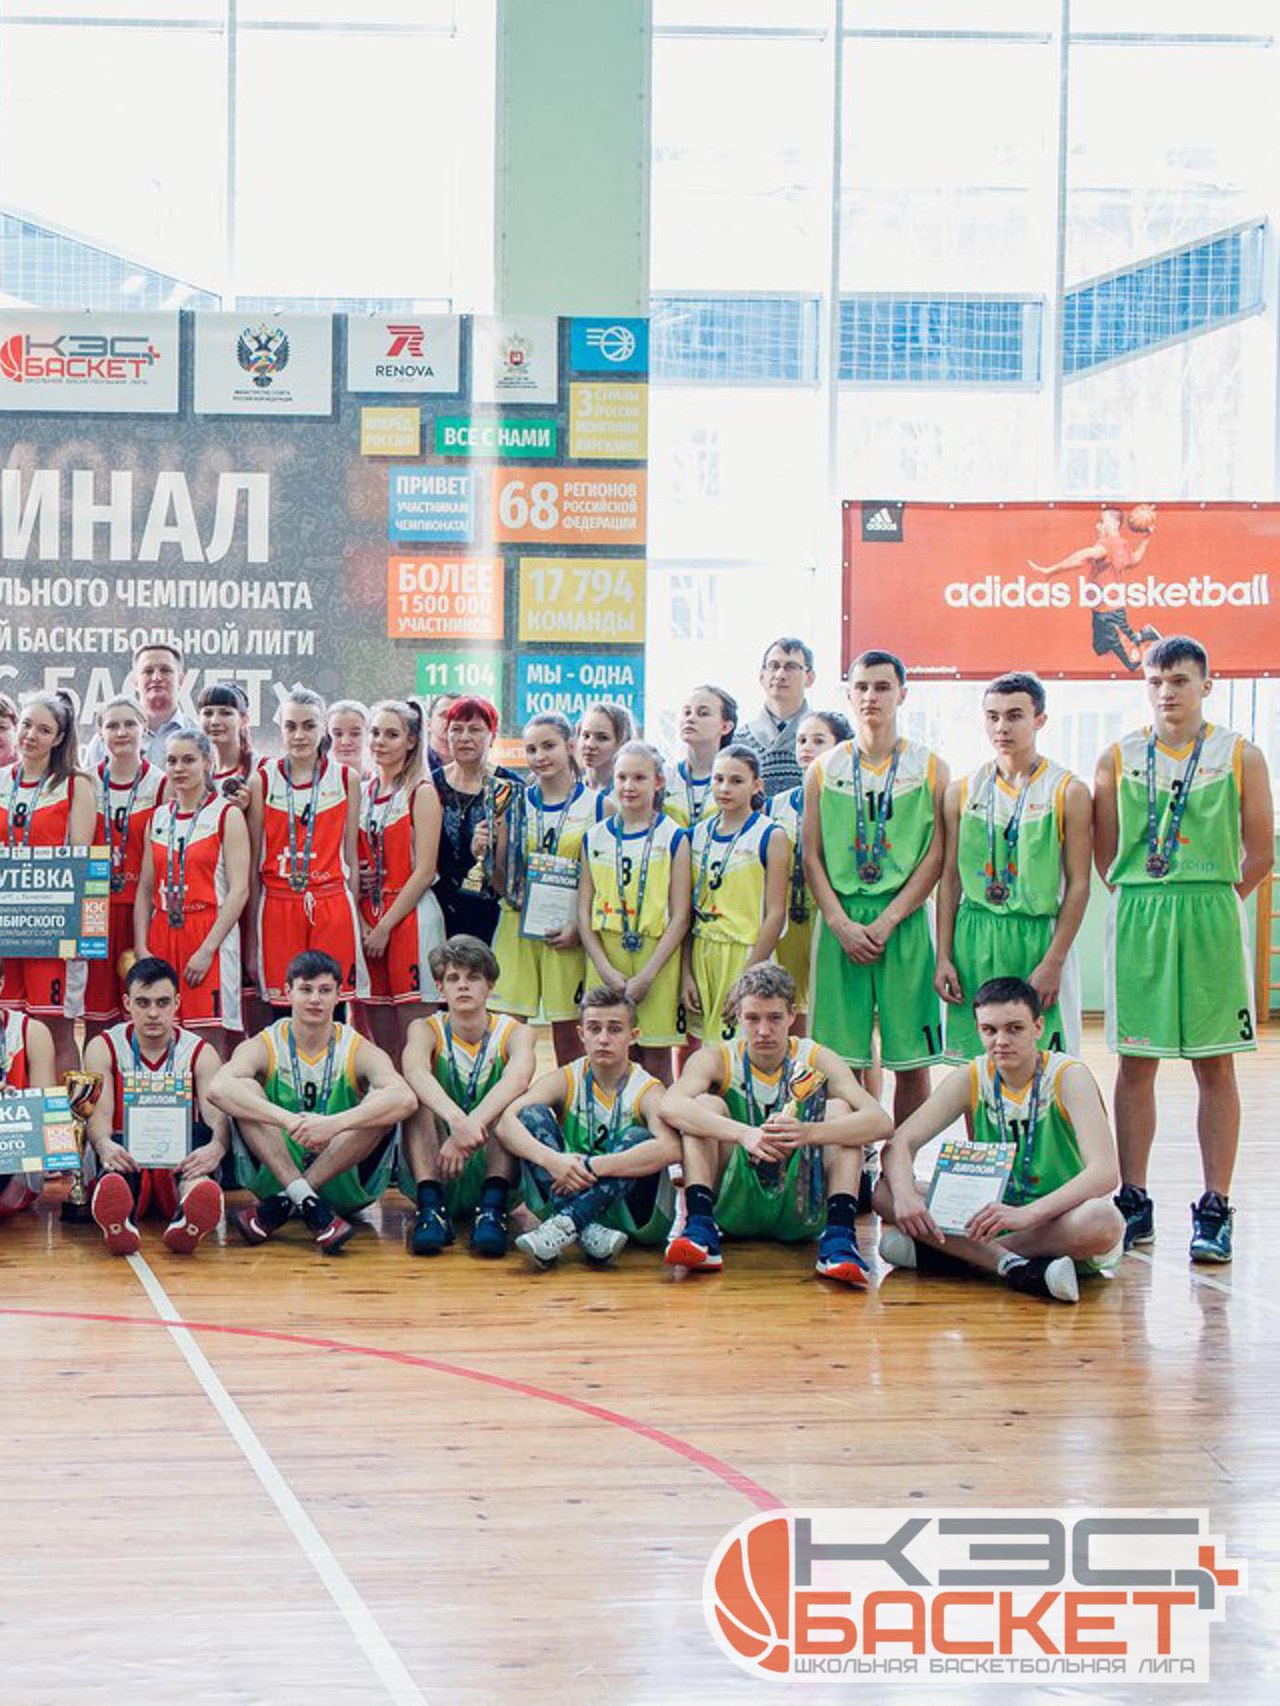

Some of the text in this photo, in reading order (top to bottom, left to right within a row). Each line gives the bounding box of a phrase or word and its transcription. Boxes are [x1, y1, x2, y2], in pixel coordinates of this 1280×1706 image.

[25, 358, 147, 378] БАСКЕТ
[375, 366, 435, 378] RENOVA
[444, 427, 478, 447] ВСЕ
[498, 428, 550, 448] НАМИ
[396, 475, 469, 496] ПРИВЕТ
[564, 483, 638, 498] РЕГИОНОВ
[499, 480, 560, 530] 68
[563, 499, 638, 514] РОССИЙСКОЙ
[563, 517, 637, 531] ФЕДЕРАЦИИ
[867, 522, 897, 531] adidas
[398, 563, 494, 593] БОЛЕЕ
[530, 568, 634, 604] 17 794
[117, 579, 314, 610] ЧЕМПИОНАТА
[944, 574, 1269, 608] adidas basketball
[528, 611, 634, 635] КОМАНДЫ
[18, 622, 239, 655] БАСКЕТБОЛЬНОЙ
[246, 629, 315, 656] ЛИГИ
[425, 664, 496, 686] 11 104
[527, 665, 562, 685] МЫ
[579, 665, 634, 688] ОДНА
[409, 964, 420, 991] 3
[50, 977, 62, 1005] 8
[676, 1003, 687, 1034] 8
[1238, 1008, 1254, 1041] 3
[303, 1081, 317, 1111] 9
